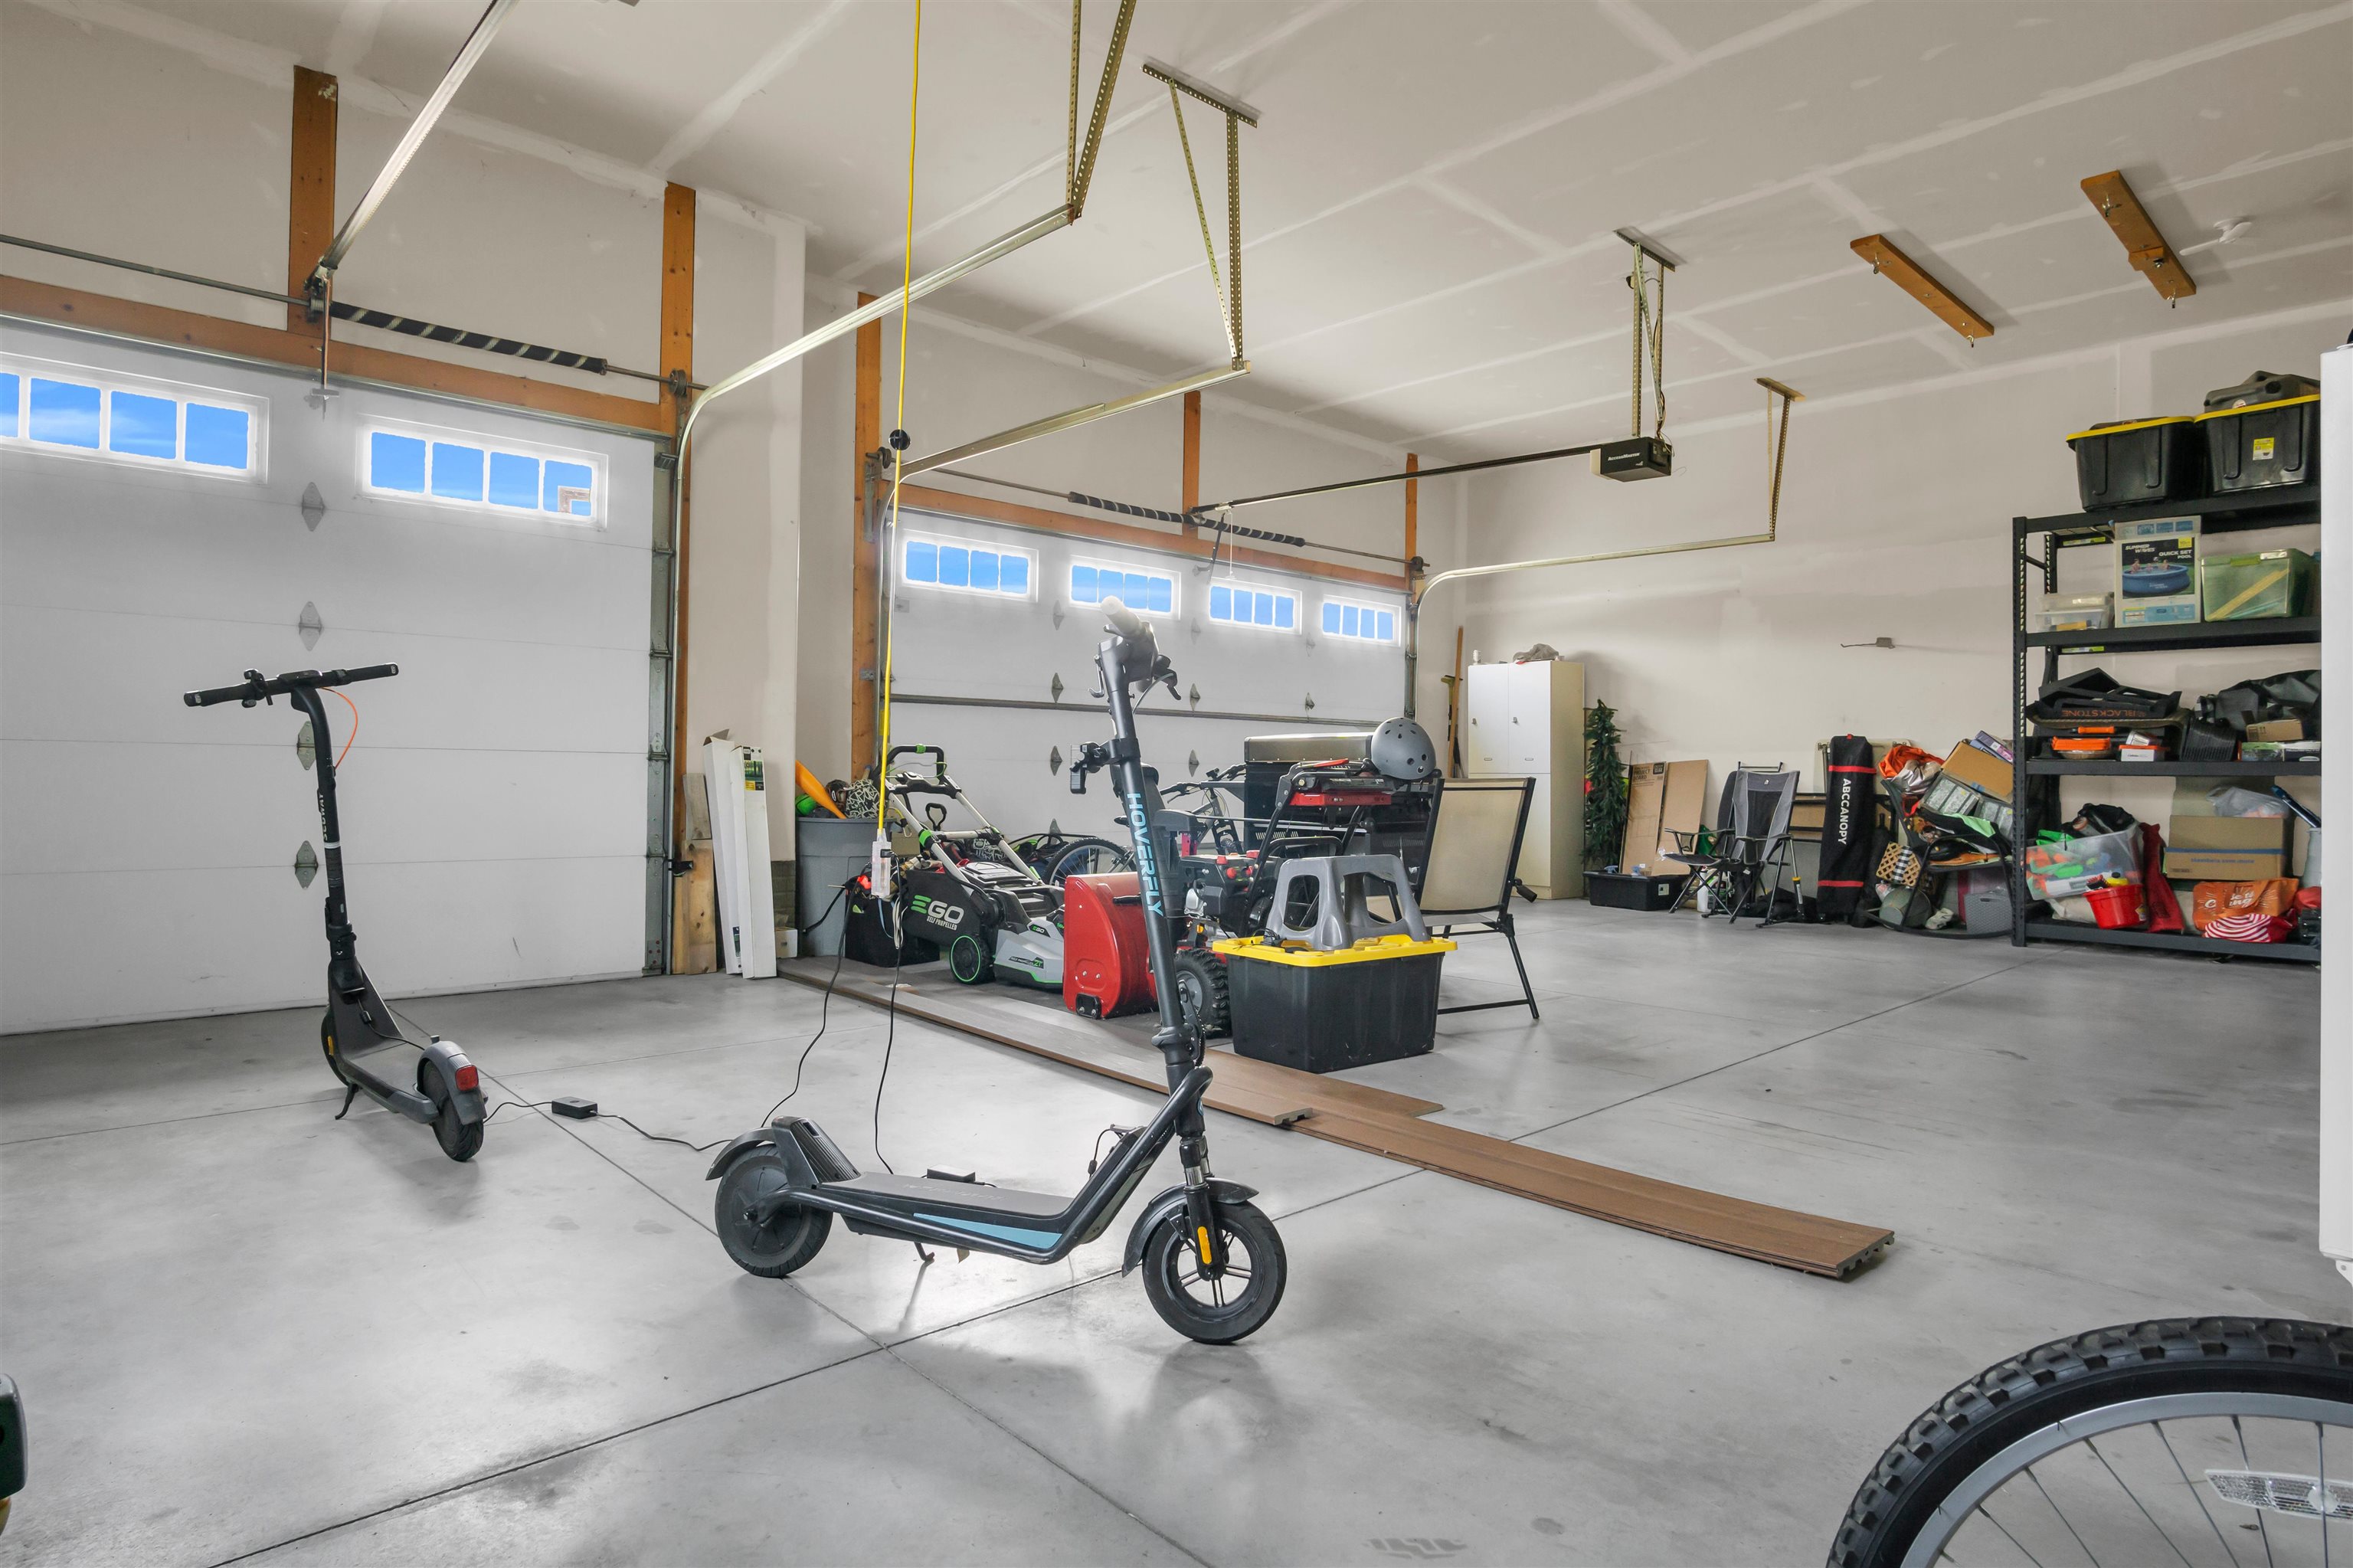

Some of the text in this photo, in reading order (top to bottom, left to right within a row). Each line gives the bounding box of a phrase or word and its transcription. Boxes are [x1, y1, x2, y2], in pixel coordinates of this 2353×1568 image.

[1838, 778, 1851, 845] ABCCANOPY
[1127, 793, 1164, 918] HOVERFLY
[911, 895, 964, 925] EGO
[927, 915, 957, 931] SELF PROPELLED
